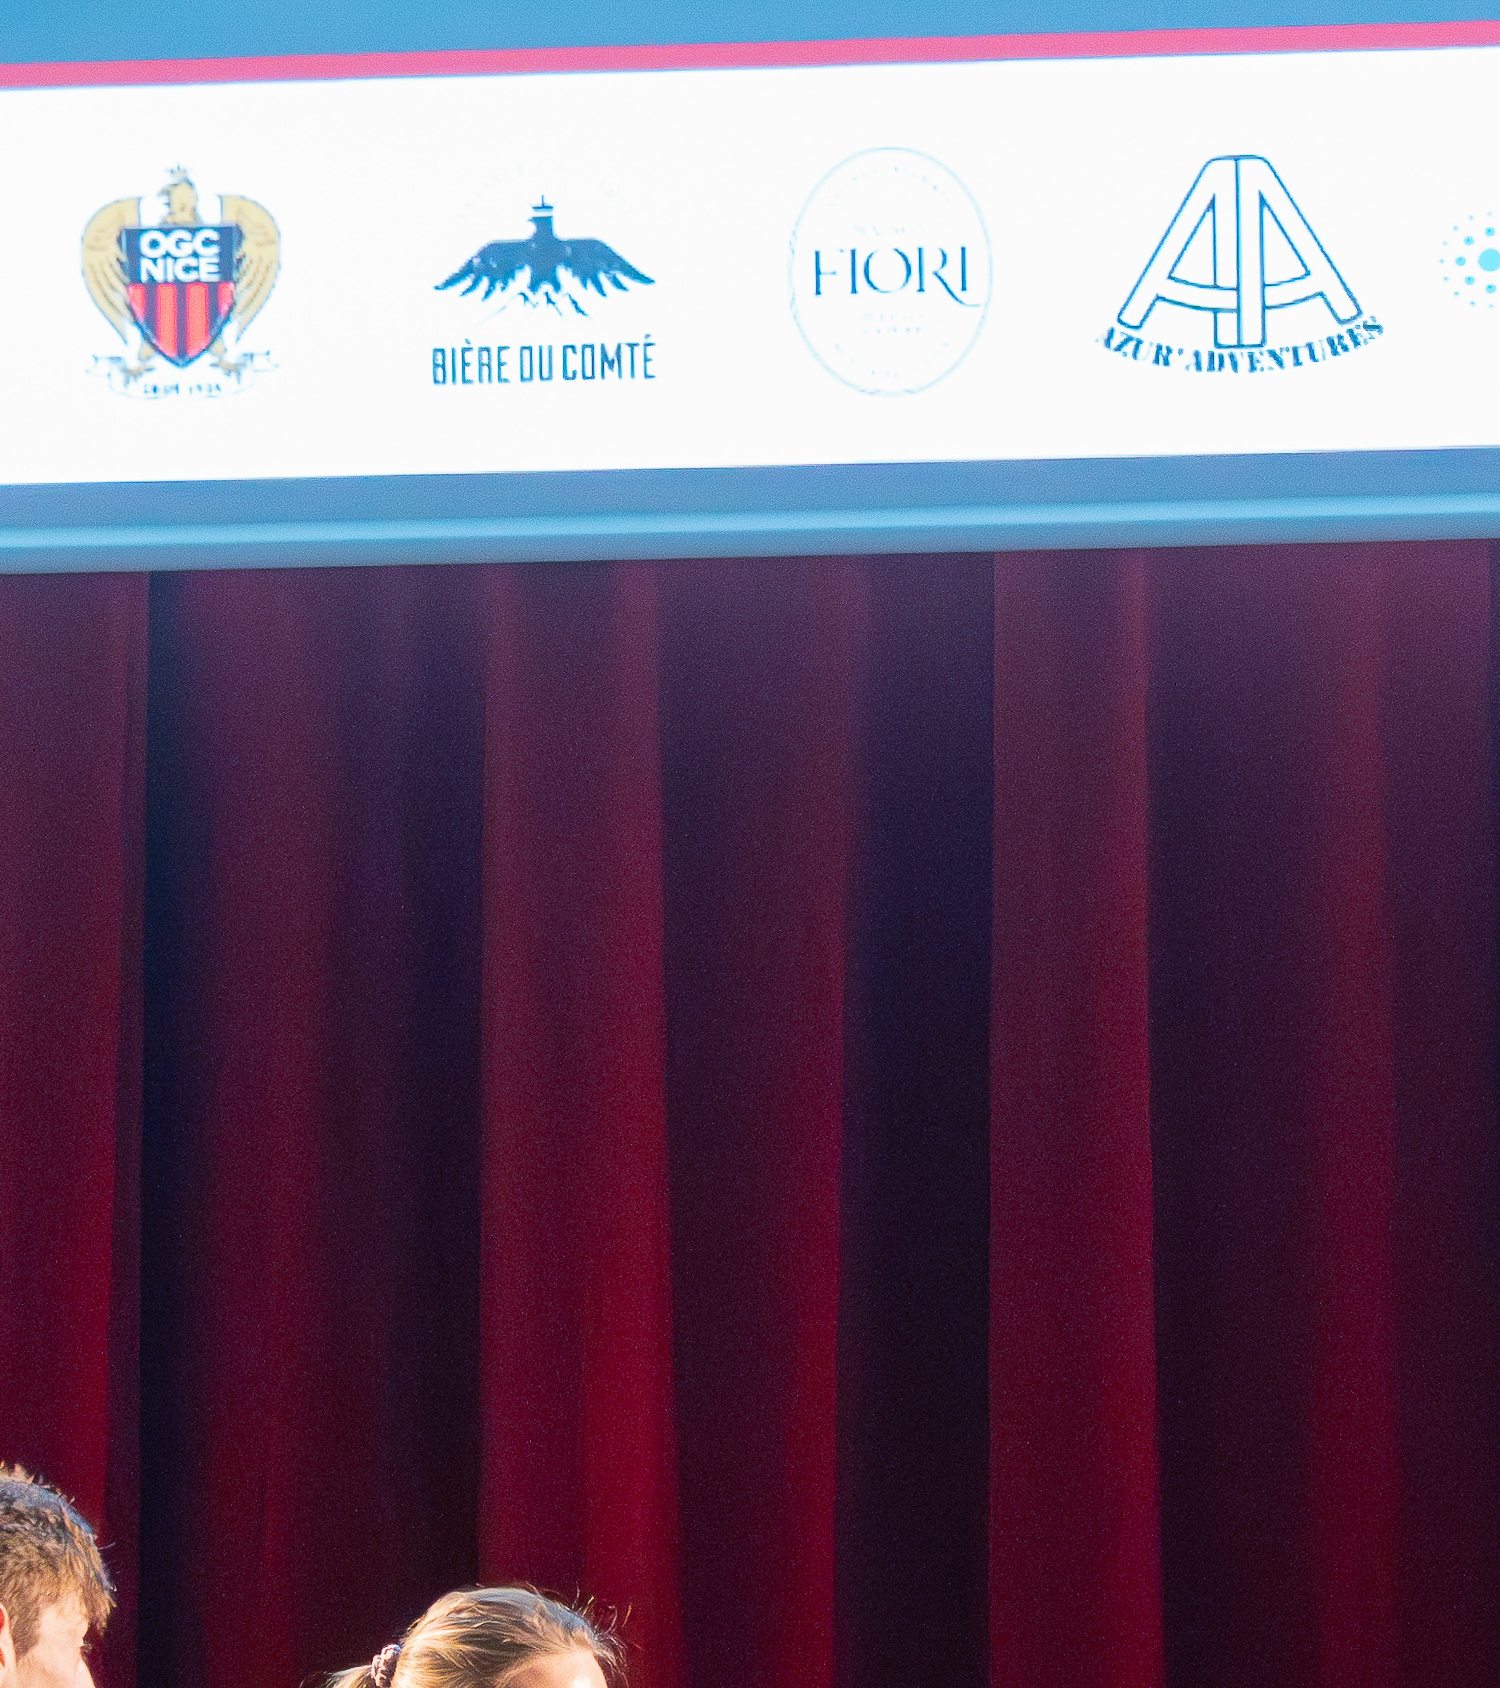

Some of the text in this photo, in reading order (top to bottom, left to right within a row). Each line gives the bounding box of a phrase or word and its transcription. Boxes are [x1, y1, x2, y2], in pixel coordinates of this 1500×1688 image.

[139, 228, 221, 259] OGC
[140, 256, 221, 283] NICE
[814, 246, 981, 308] FIORI
[432, 333, 657, 386] BIÈRE DU COMTÉ
